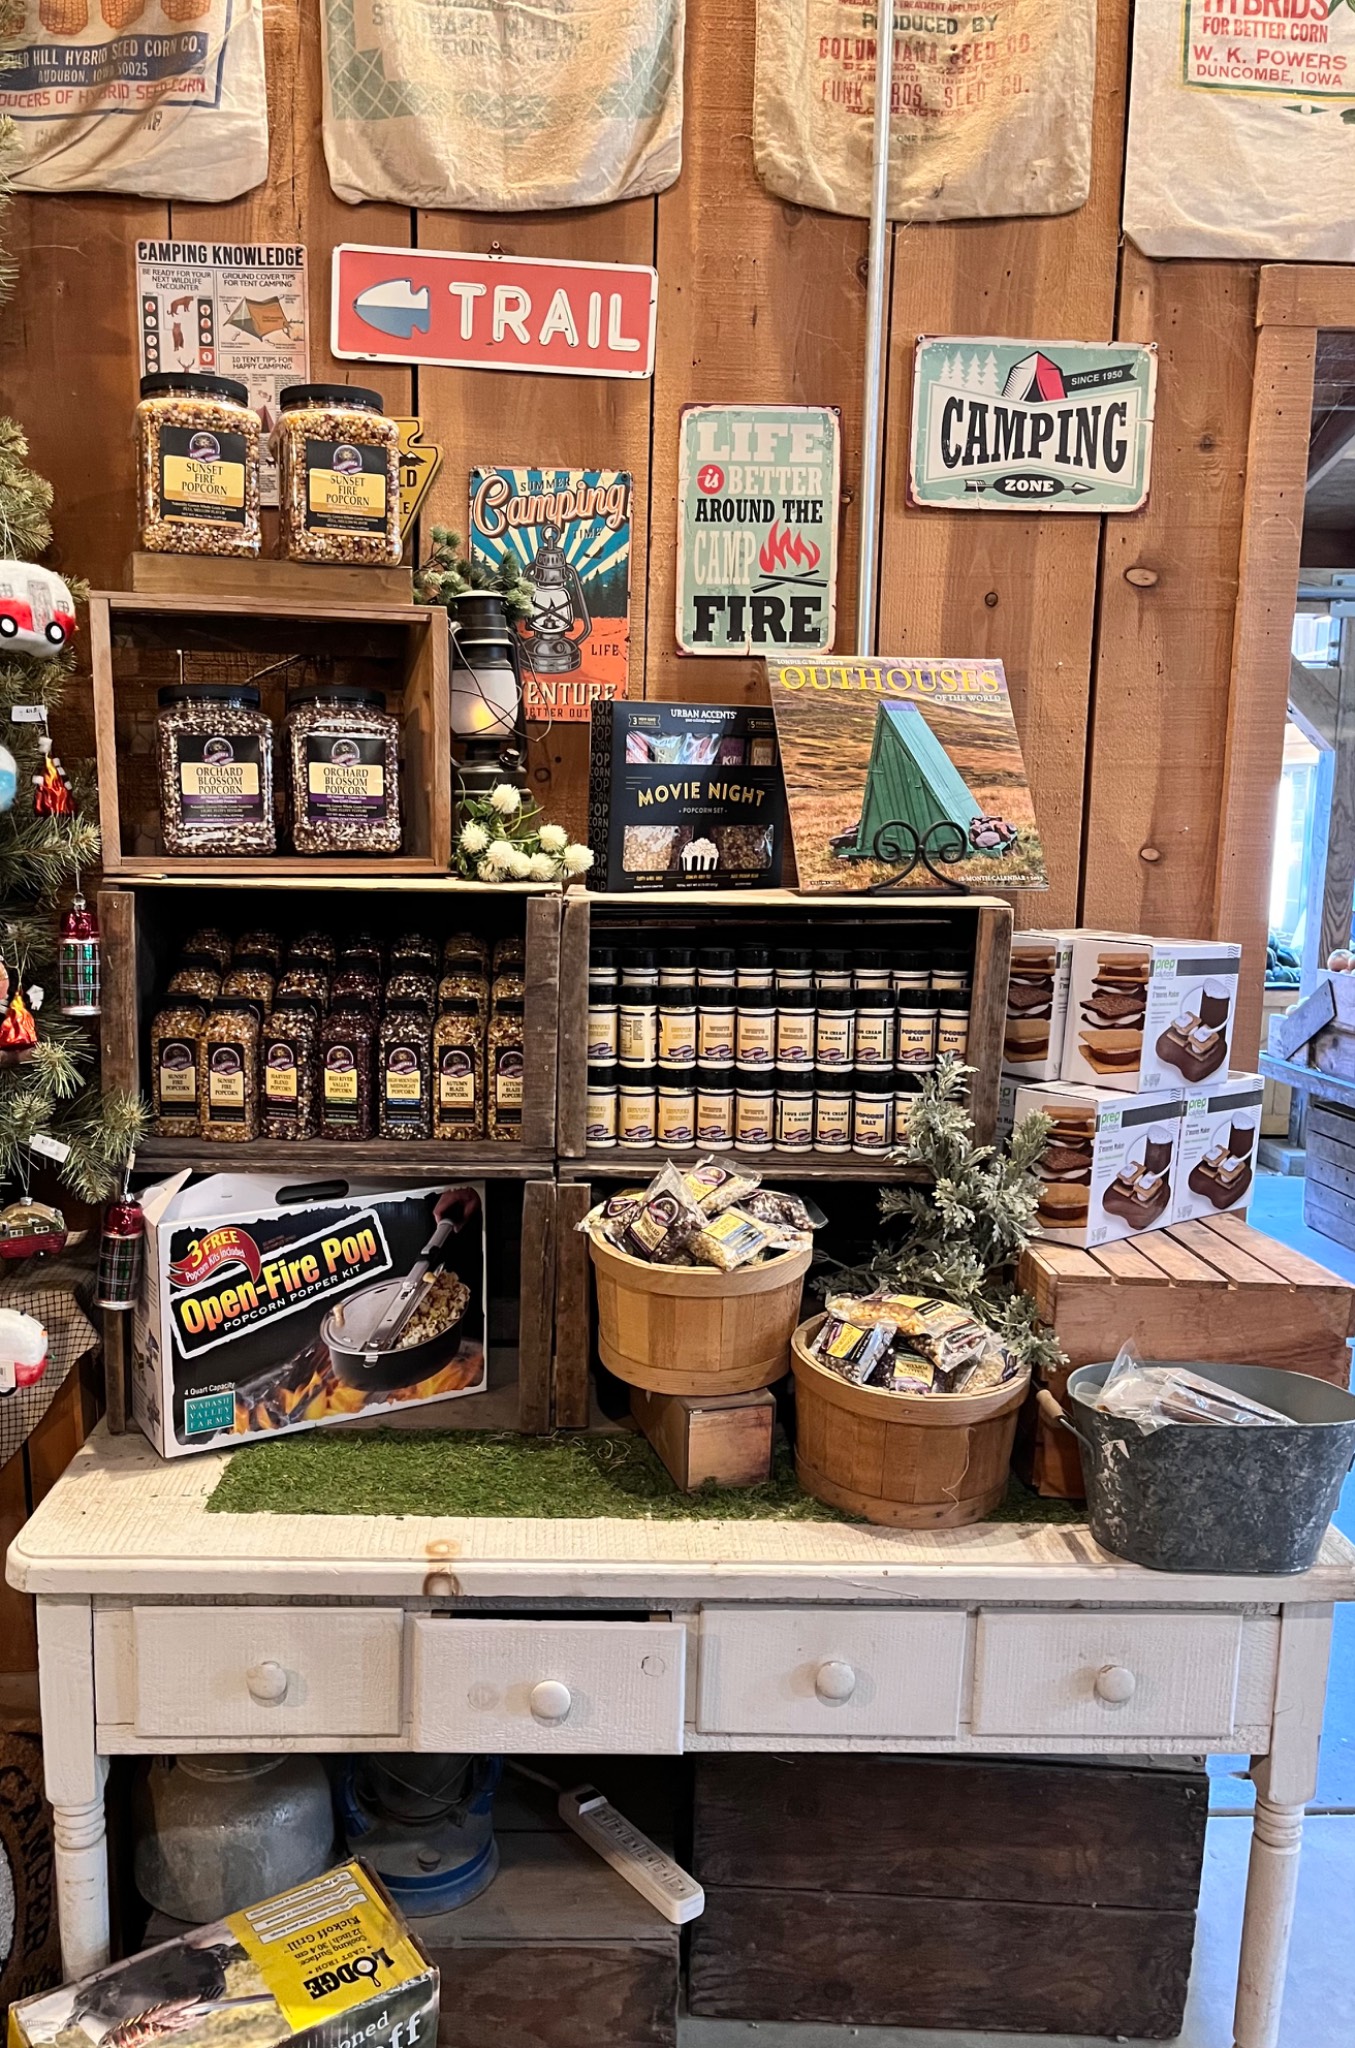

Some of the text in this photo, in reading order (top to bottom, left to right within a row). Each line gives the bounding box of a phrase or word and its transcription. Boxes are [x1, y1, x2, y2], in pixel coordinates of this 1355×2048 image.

[972, 14, 999, 33] BY
[1203, 16, 1328, 43] FOR BETTER CORN
[33, 49, 59, 66] HILL
[65, 46, 107, 66] HYBRID
[112, 38, 139, 60] SEED
[144, 37, 178, 58] CORN
[181, 35, 201, 53] CO.
[1193, 45, 1347, 70] W. K. POWERS
[1196, 64, 1343, 86] DUNCOMBE, IOWA
[55, 90, 74, 104] OF
[822, 80, 863, 106] FUNK
[138, 242, 304, 266] CAMPING KNOWLEDGE
[152, 269, 175, 277] READY
[152, 276, 202, 285] NEXT WILDLIFE
[156, 283, 199, 291] ENCOUNTER
[448, 282, 641, 352] TRAIL
[1070, 369, 1123, 386] SINCE 1950
[941, 396, 1128, 474] CAMPING
[696, 422, 823, 463] LIFE
[186, 463, 223, 475] SUNSET
[194, 473, 215, 484] FIRE
[330, 475, 365, 487] SUNSET
[520, 477, 570, 492] SUMMER
[703, 466, 823, 496] is BETTER
[181, 481, 227, 495] POPCORN
[338, 486, 357, 495] FIRE
[1004, 479, 1054, 493] ZONE
[326, 494, 370, 506] POPCORN
[473, 474, 628, 537] Camping
[695, 498, 823, 523] AROUND THE
[573, 528, 602, 540] TIME
[694, 530, 756, 585] CAMP
[692, 595, 822, 643] FIRE
[591, 643, 620, 656] LIFE
[779, 666, 1000, 693] OUTHOUSES
[522, 681, 617, 706] ENTURE
[592, 701, 611, 715] POP
[670, 709, 737, 720] URBAN ACCENTS
[633, 716, 638, 726] 3
[592, 752, 610, 766] POP
[196, 767, 243, 777] ORCHARD
[323, 767, 369, 777] ORCHARD
[198, 777, 243, 786] BLOSSOM
[325, 777, 368, 787] BLOSSOM
[198, 785, 243, 794] POPCORN
[325, 785, 368, 795] POPCORN
[638, 782, 765, 808] MOVIE NIGHT
[589, 803, 608, 817] POP
[1155, 959, 1175, 970] prep
[1188, 1098, 1207, 1110] prep
[1101, 1112, 1121, 1123] prep
[187, 1239, 203, 1268] 3
[202, 1230, 240, 1256] FREE
[185, 1246, 246, 1282] Popcorn Kits Included
[180, 1227, 378, 1335] Open-Fire Pop
[224, 1263, 362, 1332] POPCORN POPPER KIT
[190, 1386, 208, 1395] Quart
[209, 1382, 236, 1392] Capacity
[190, 1397, 230, 1411] WABASH
[190, 1407, 229, 1419] VALLEY
[190, 1417, 230, 1429] FARMS
[287, 1915, 361, 1952] Kickoff Grill
[294, 1928, 362, 1960] 12 30.4 cm
[299, 1934, 367, 1966] Cooking Surface
[314, 1946, 366, 1971] CAST IRON
[303, 1946, 396, 2000] LODGE
